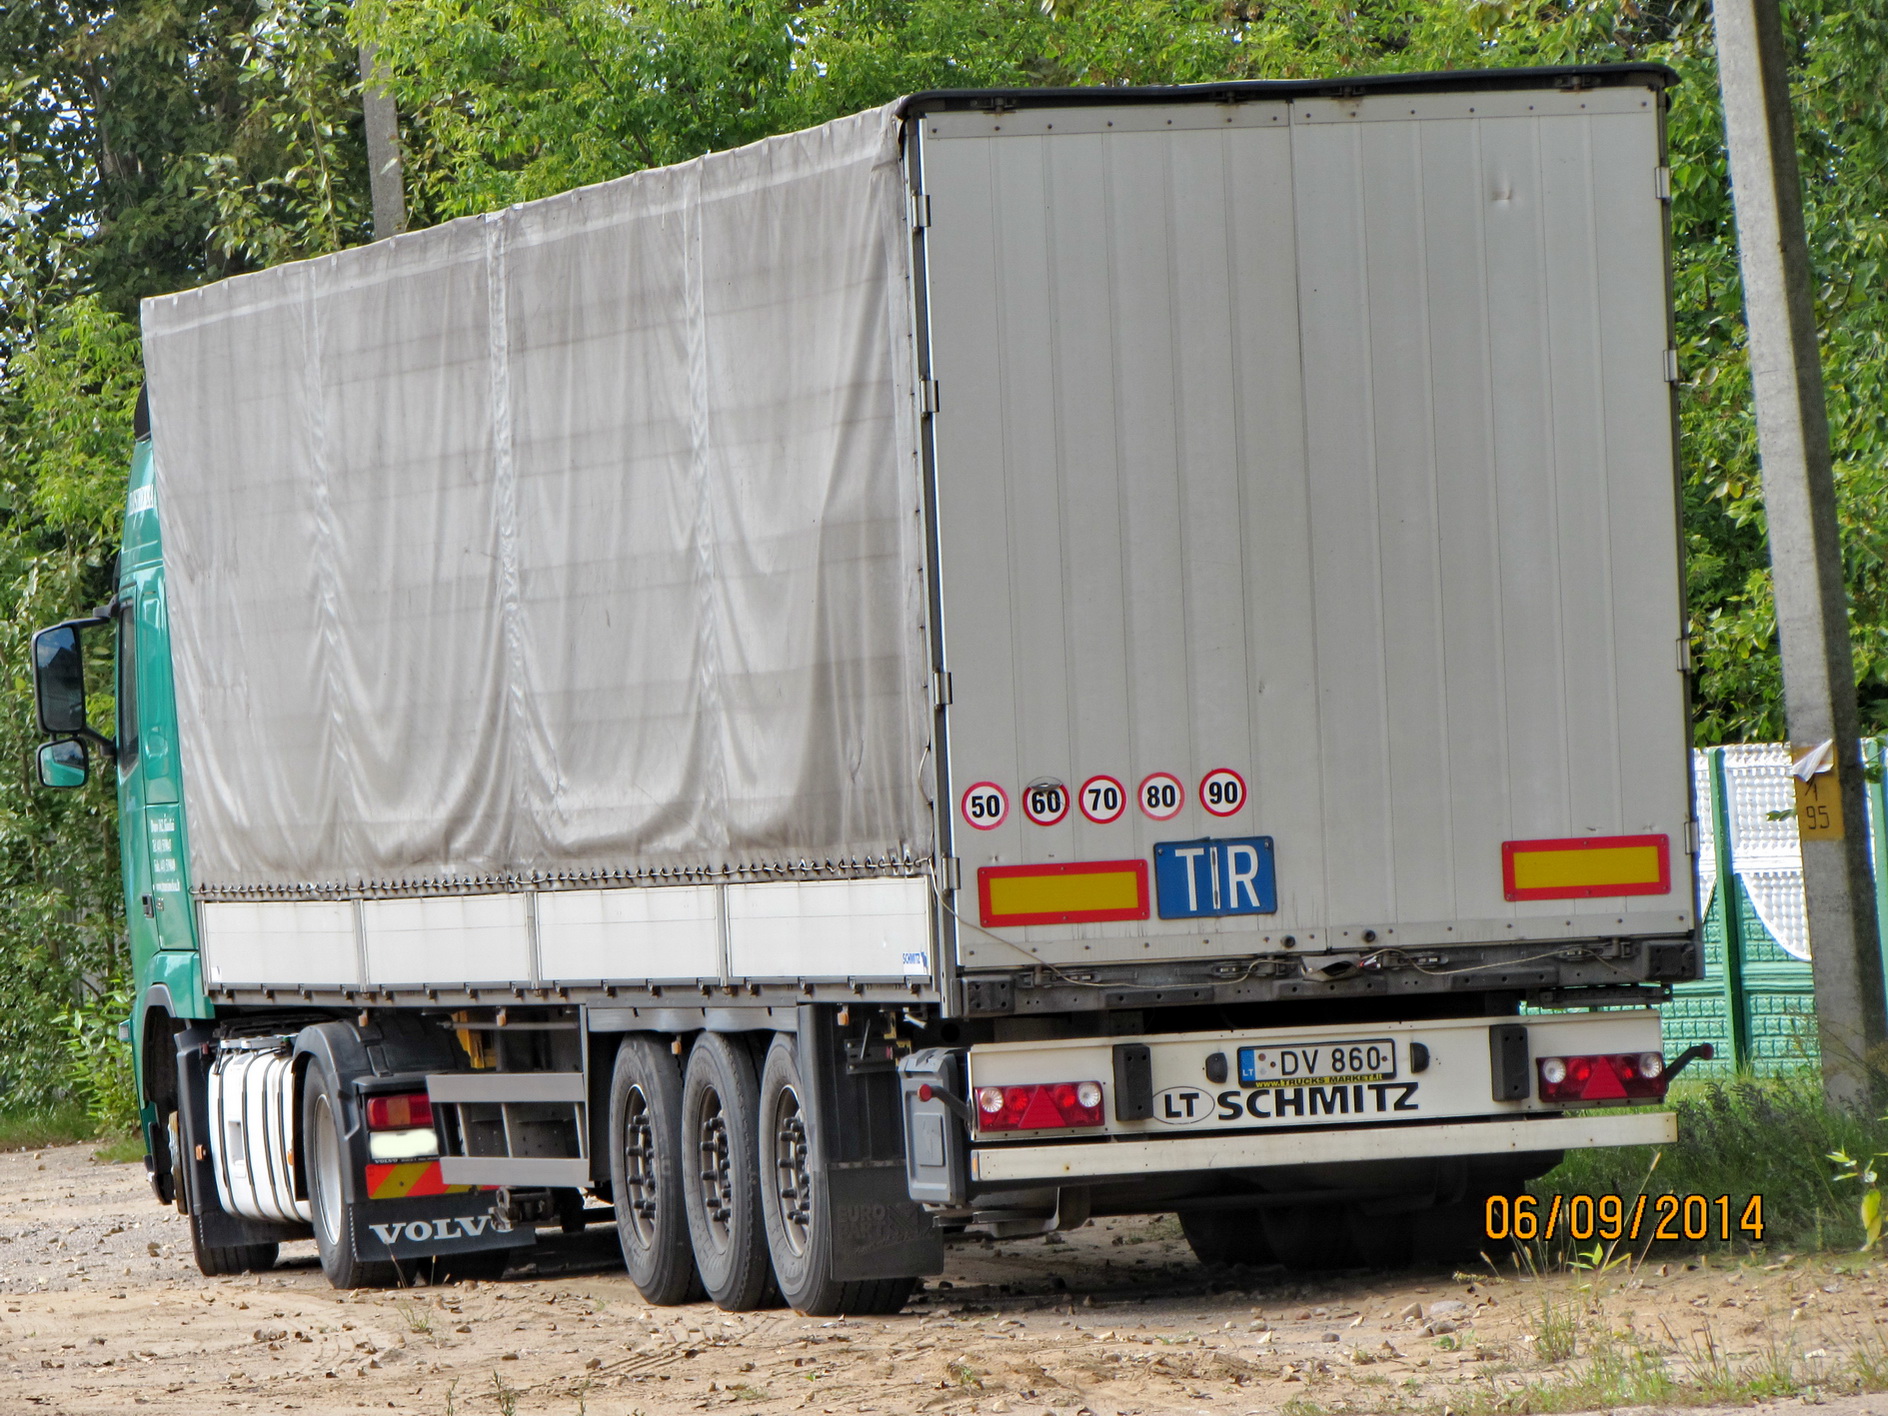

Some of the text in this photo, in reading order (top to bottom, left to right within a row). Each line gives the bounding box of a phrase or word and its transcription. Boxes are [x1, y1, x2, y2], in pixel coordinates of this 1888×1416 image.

[1031, 789, 1061, 814] 60
[1088, 786, 1118, 810] 70
[1146, 784, 1176, 808] 80
[1208, 781, 1238, 805] 90
[971, 794, 1000, 818] 50
[1806, 805, 1830, 830] 95
[1174, 844, 1261, 912] TIR
[1242, 1068, 1254, 1077] LT
[1281, 1046, 1381, 1076] DV 860
[1164, 1092, 1200, 1119] LT
[1216, 1082, 1419, 1121] SCHMITZ
